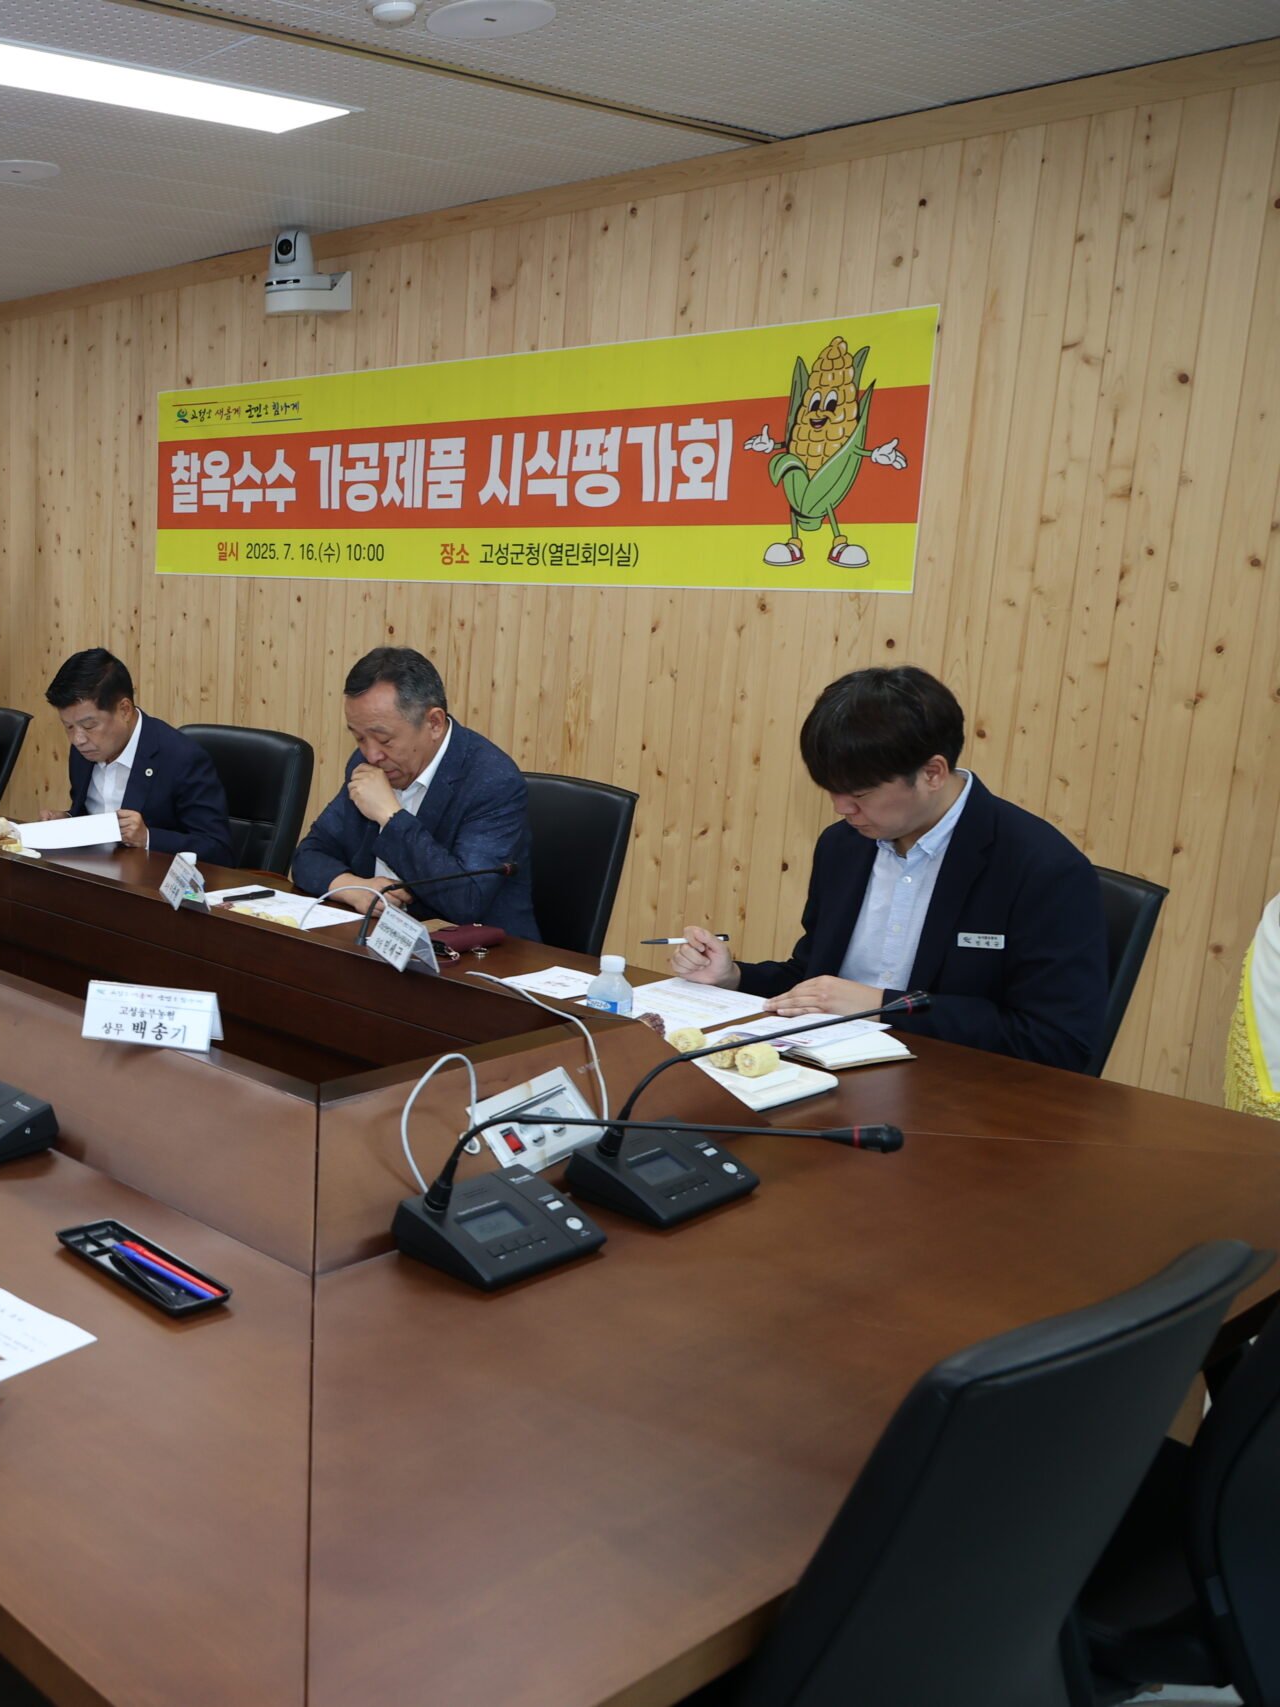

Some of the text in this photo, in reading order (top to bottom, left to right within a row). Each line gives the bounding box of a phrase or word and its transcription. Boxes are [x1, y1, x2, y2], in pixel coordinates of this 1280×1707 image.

[170, 417, 733, 514] 찰옥수수 가공제품 시식평가회
[218, 542, 384, 563] 일시 2025. 7. 16.(수) 10:00
[439, 542, 640, 568] 장소 고성군청(열린회의실)
[102, 1021, 125, 1036] 상무
